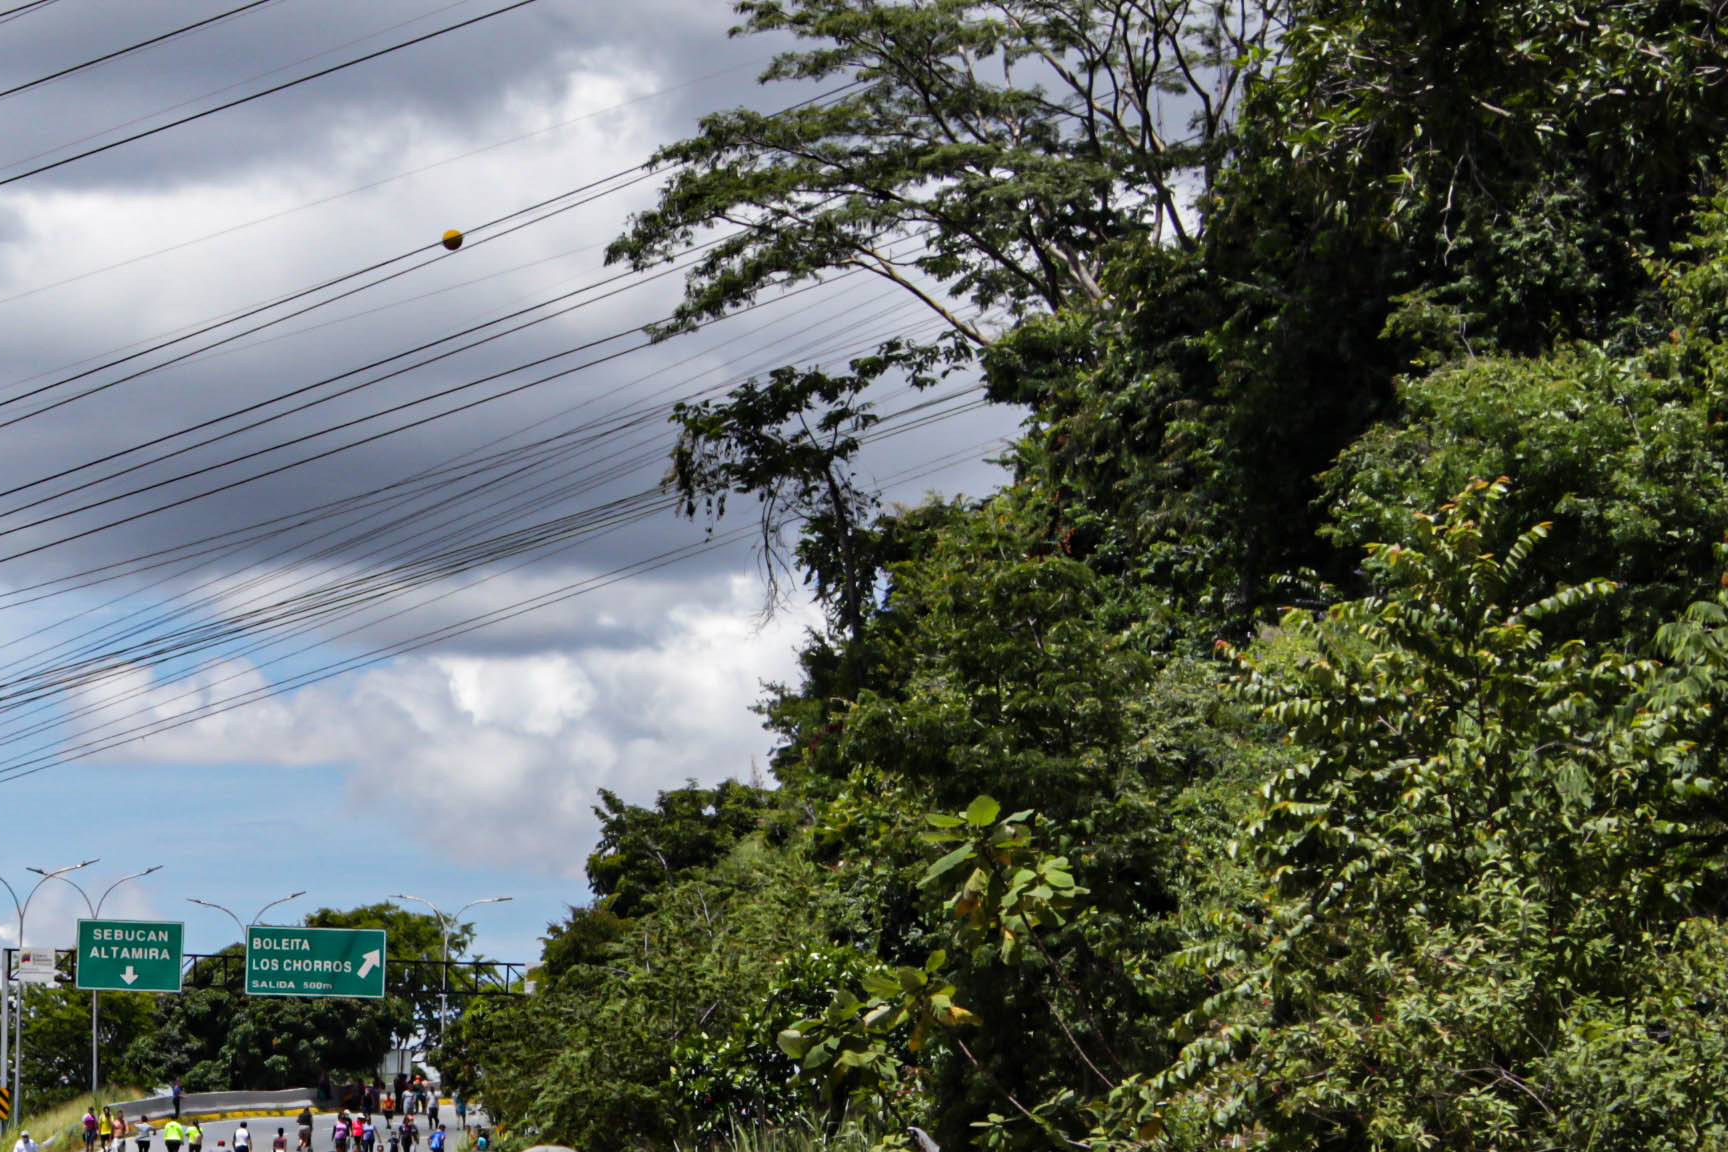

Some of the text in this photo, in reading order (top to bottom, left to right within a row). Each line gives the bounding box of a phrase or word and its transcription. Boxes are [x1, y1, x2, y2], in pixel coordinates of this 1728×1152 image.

[92, 928, 169, 942] SEBUCAN
[252, 937, 311, 951] BOLEITA
[89, 946, 170, 960] ALTAMIRA
[252, 958, 352, 973] LOS CHORROS
[251, 980, 333, 990] SALIDA 500m
